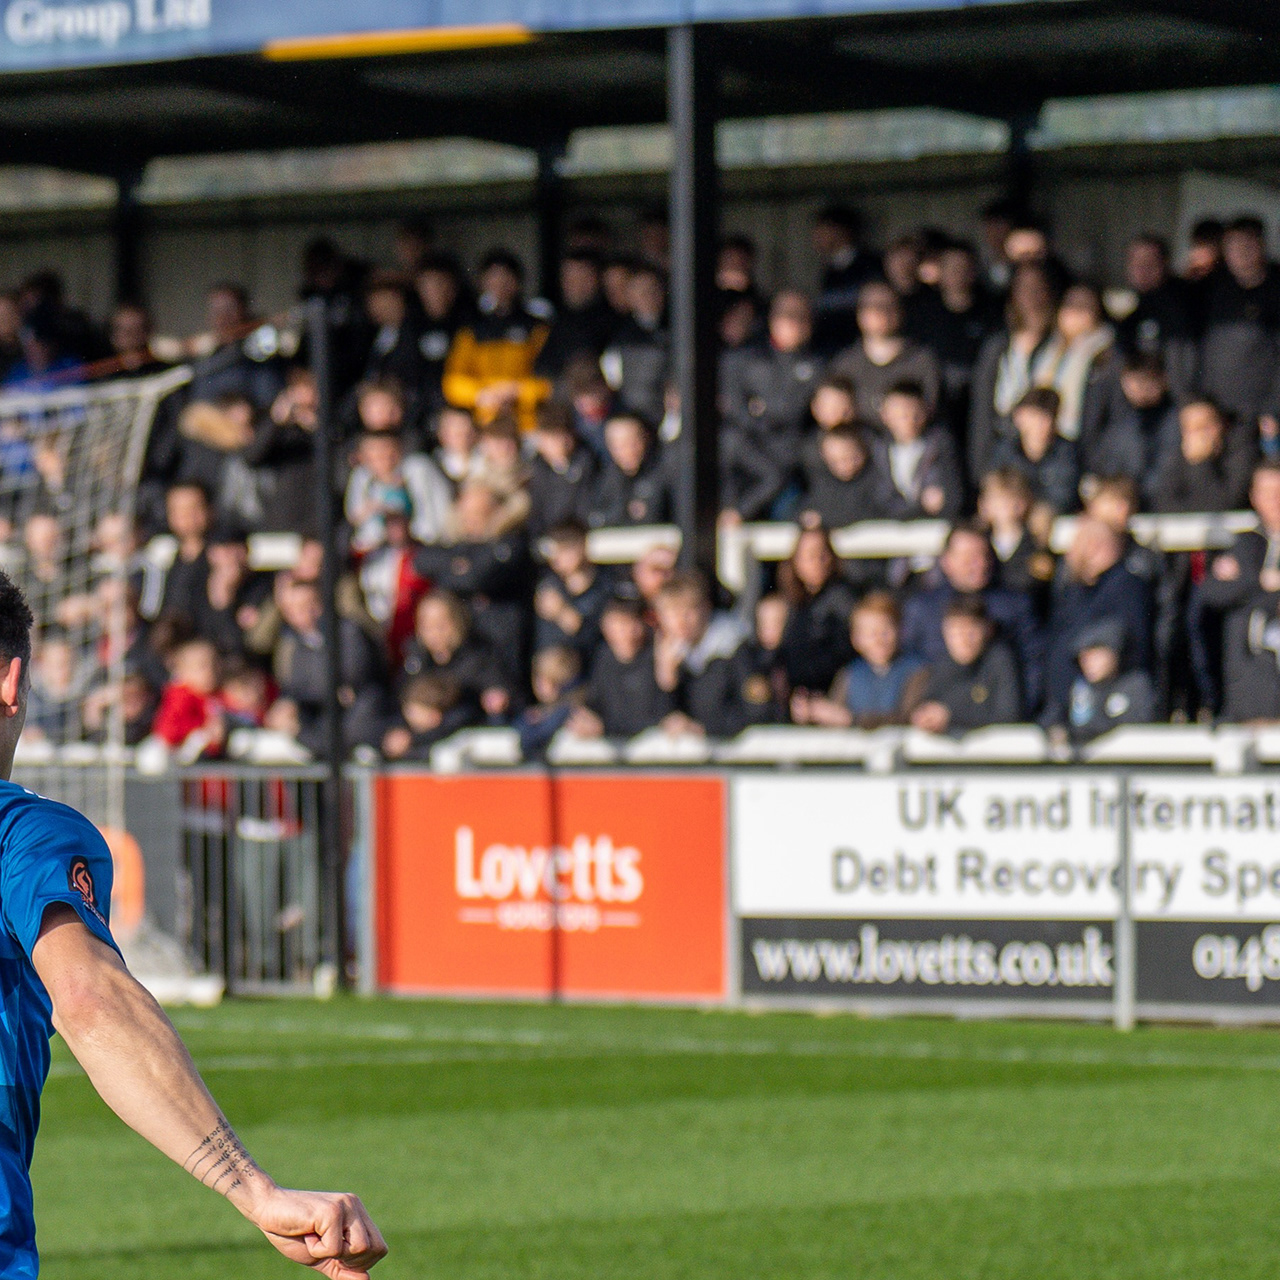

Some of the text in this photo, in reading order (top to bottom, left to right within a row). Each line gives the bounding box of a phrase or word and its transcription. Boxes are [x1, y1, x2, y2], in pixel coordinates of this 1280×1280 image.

[898, 787, 966, 832] UK
[984, 786, 1071, 832] and
[455, 824, 644, 904] Lovetts
[832, 848, 938, 894] Debt
[752, 923, 1114, 987] www.lovetts.co.uk
